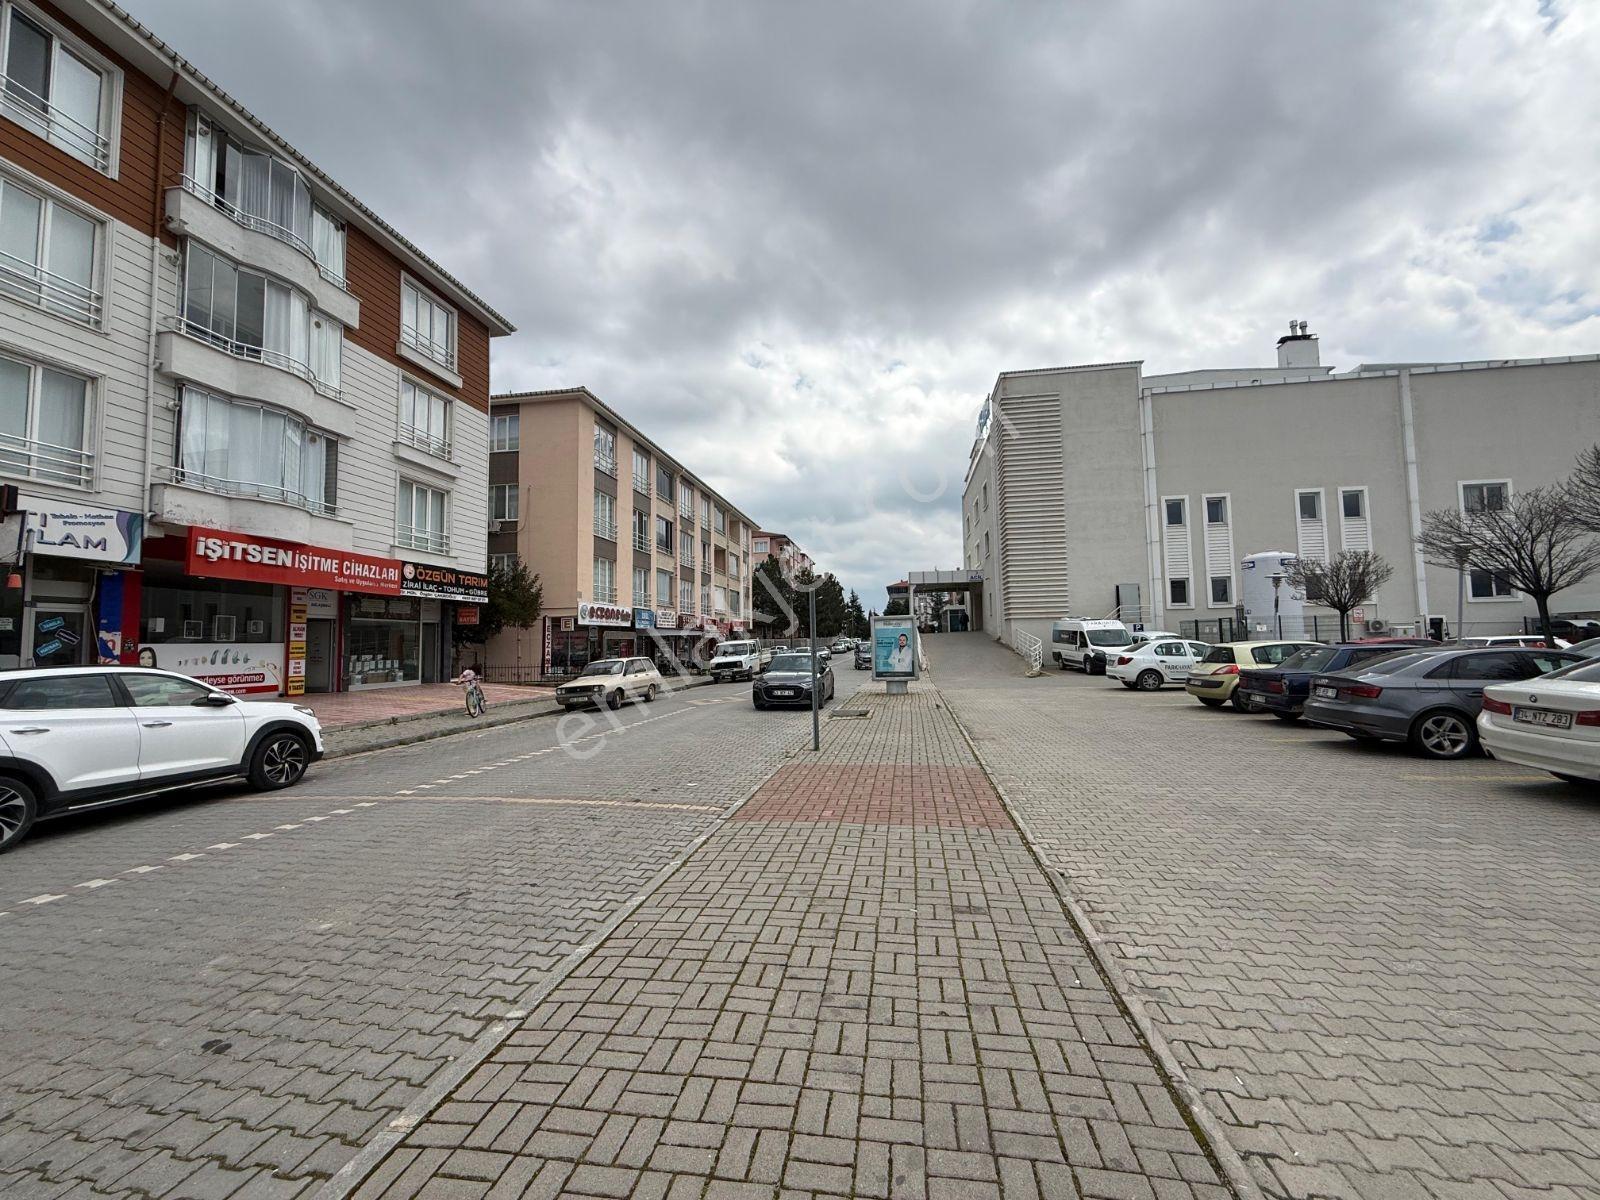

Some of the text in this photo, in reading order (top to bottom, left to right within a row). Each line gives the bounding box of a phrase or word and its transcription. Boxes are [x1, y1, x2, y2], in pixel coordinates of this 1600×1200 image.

[34, 528, 108, 552] LAM
[295, 554, 339, 573] İŞİTME
[342, 558, 399, 582] CİHAZLARI
[416, 566, 488, 588] ÖZGÜN TARIM
[309, 590, 328, 601] SGK
[423, 582, 438, 592] İLAÇ
[443, 585, 465, 595] TOHUM
[468, 588, 488, 597] GÜBRE
[563, 620, 571, 629] E
[227, 674, 264, 685] görünmez
[1519, 710, 1568, 724] 34 NTZ 283
